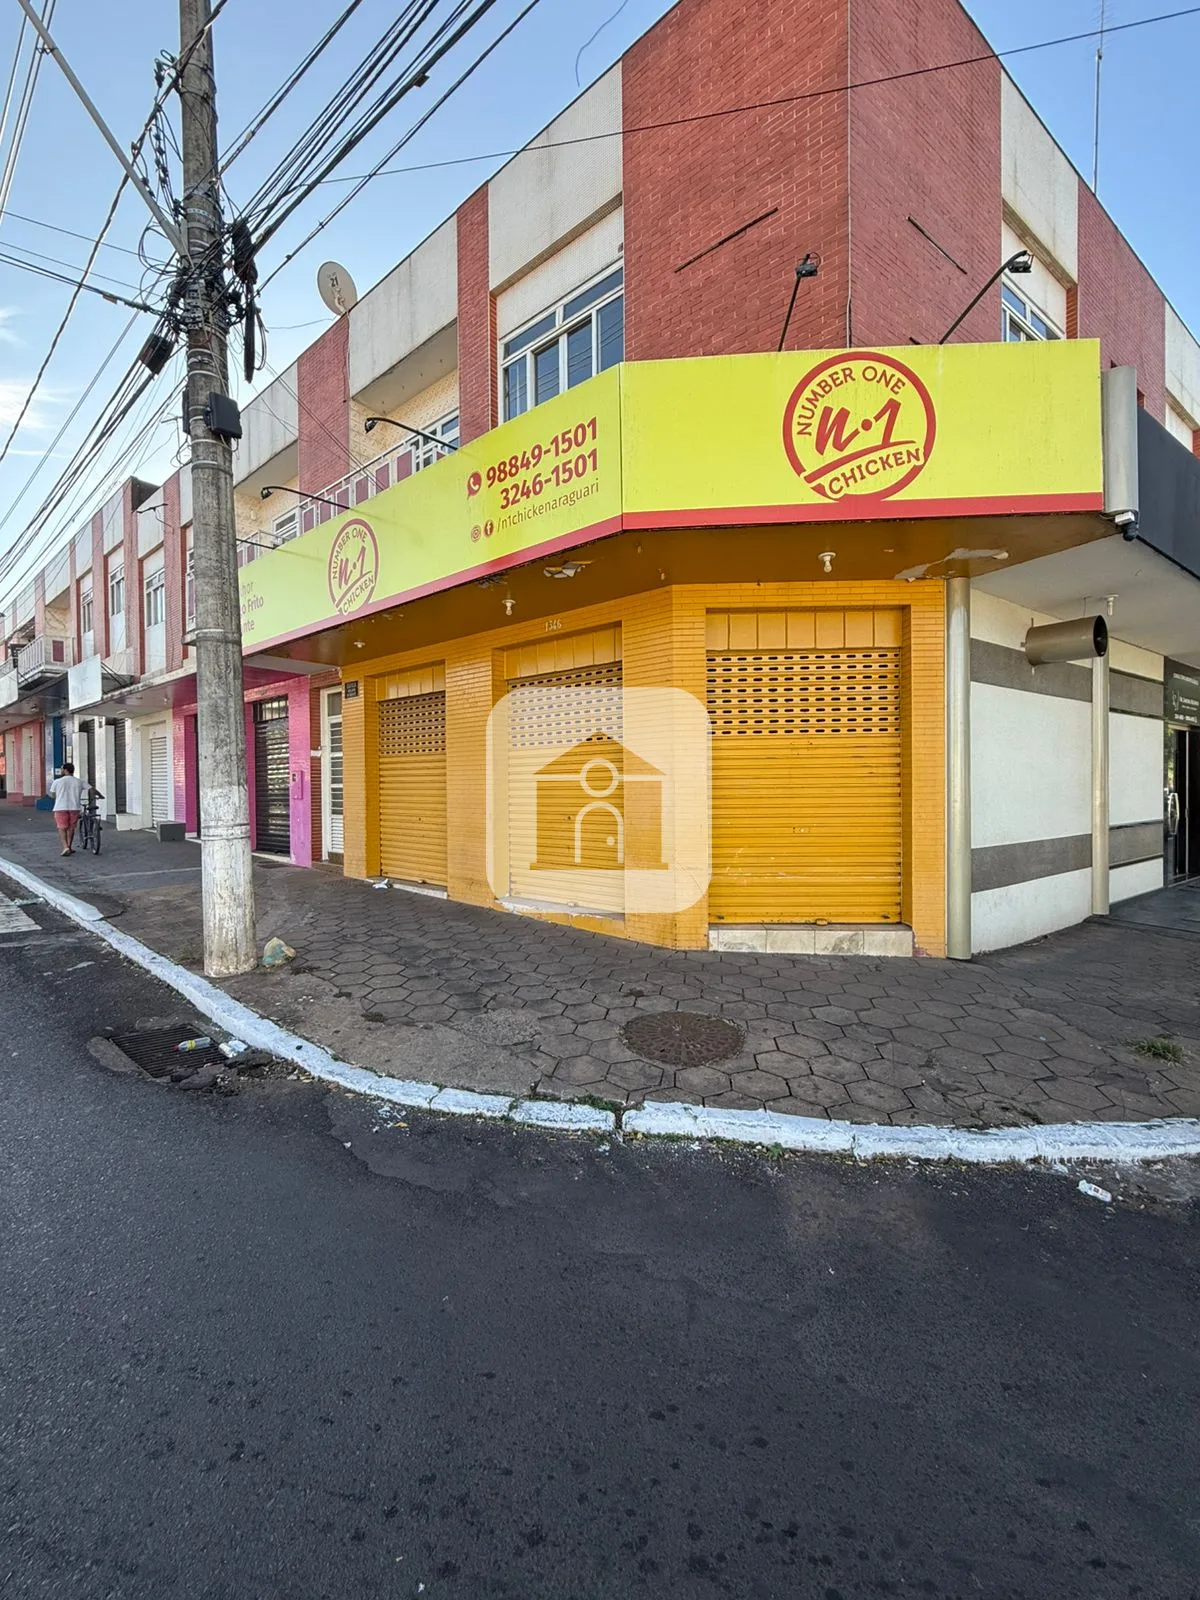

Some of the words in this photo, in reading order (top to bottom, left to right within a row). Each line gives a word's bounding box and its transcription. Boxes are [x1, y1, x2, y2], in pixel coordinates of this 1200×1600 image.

[797, 367, 855, 436] NUMBER
[862, 366, 905, 394] ONE
[486, 416, 597, 488] 98849-1501
[828, 448, 920, 494] CHICKEN
[500, 448, 598, 509] 3246-1501
[497, 478, 599, 532] /n1chickenaraguari
[332, 531, 351, 579] NUMBER
[351, 528, 368, 543] ONE
[247, 594, 264, 613] Frito
[343, 575, 374, 613] CHICKEN
